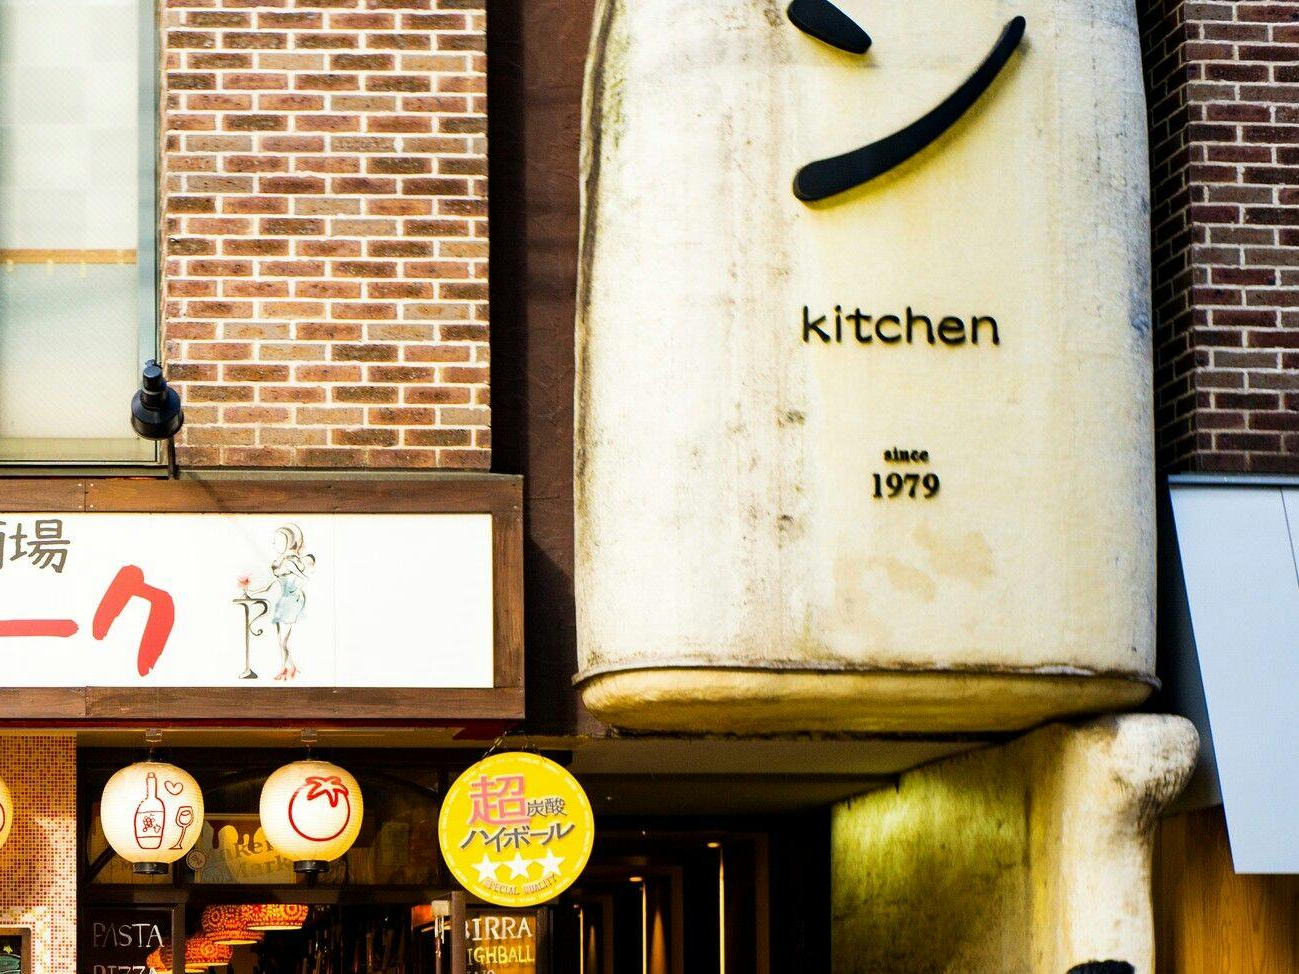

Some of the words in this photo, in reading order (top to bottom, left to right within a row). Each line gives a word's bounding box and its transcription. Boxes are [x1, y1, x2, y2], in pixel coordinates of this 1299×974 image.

[802, 304, 1000, 345] kitchen
[883, 447, 929, 462] since
[872, 472, 940, 499] 1979
[460, 822, 575, 853] ハイボール
[93, 922, 164, 948] PASTA
[467, 945, 535, 966] IGHBALL
